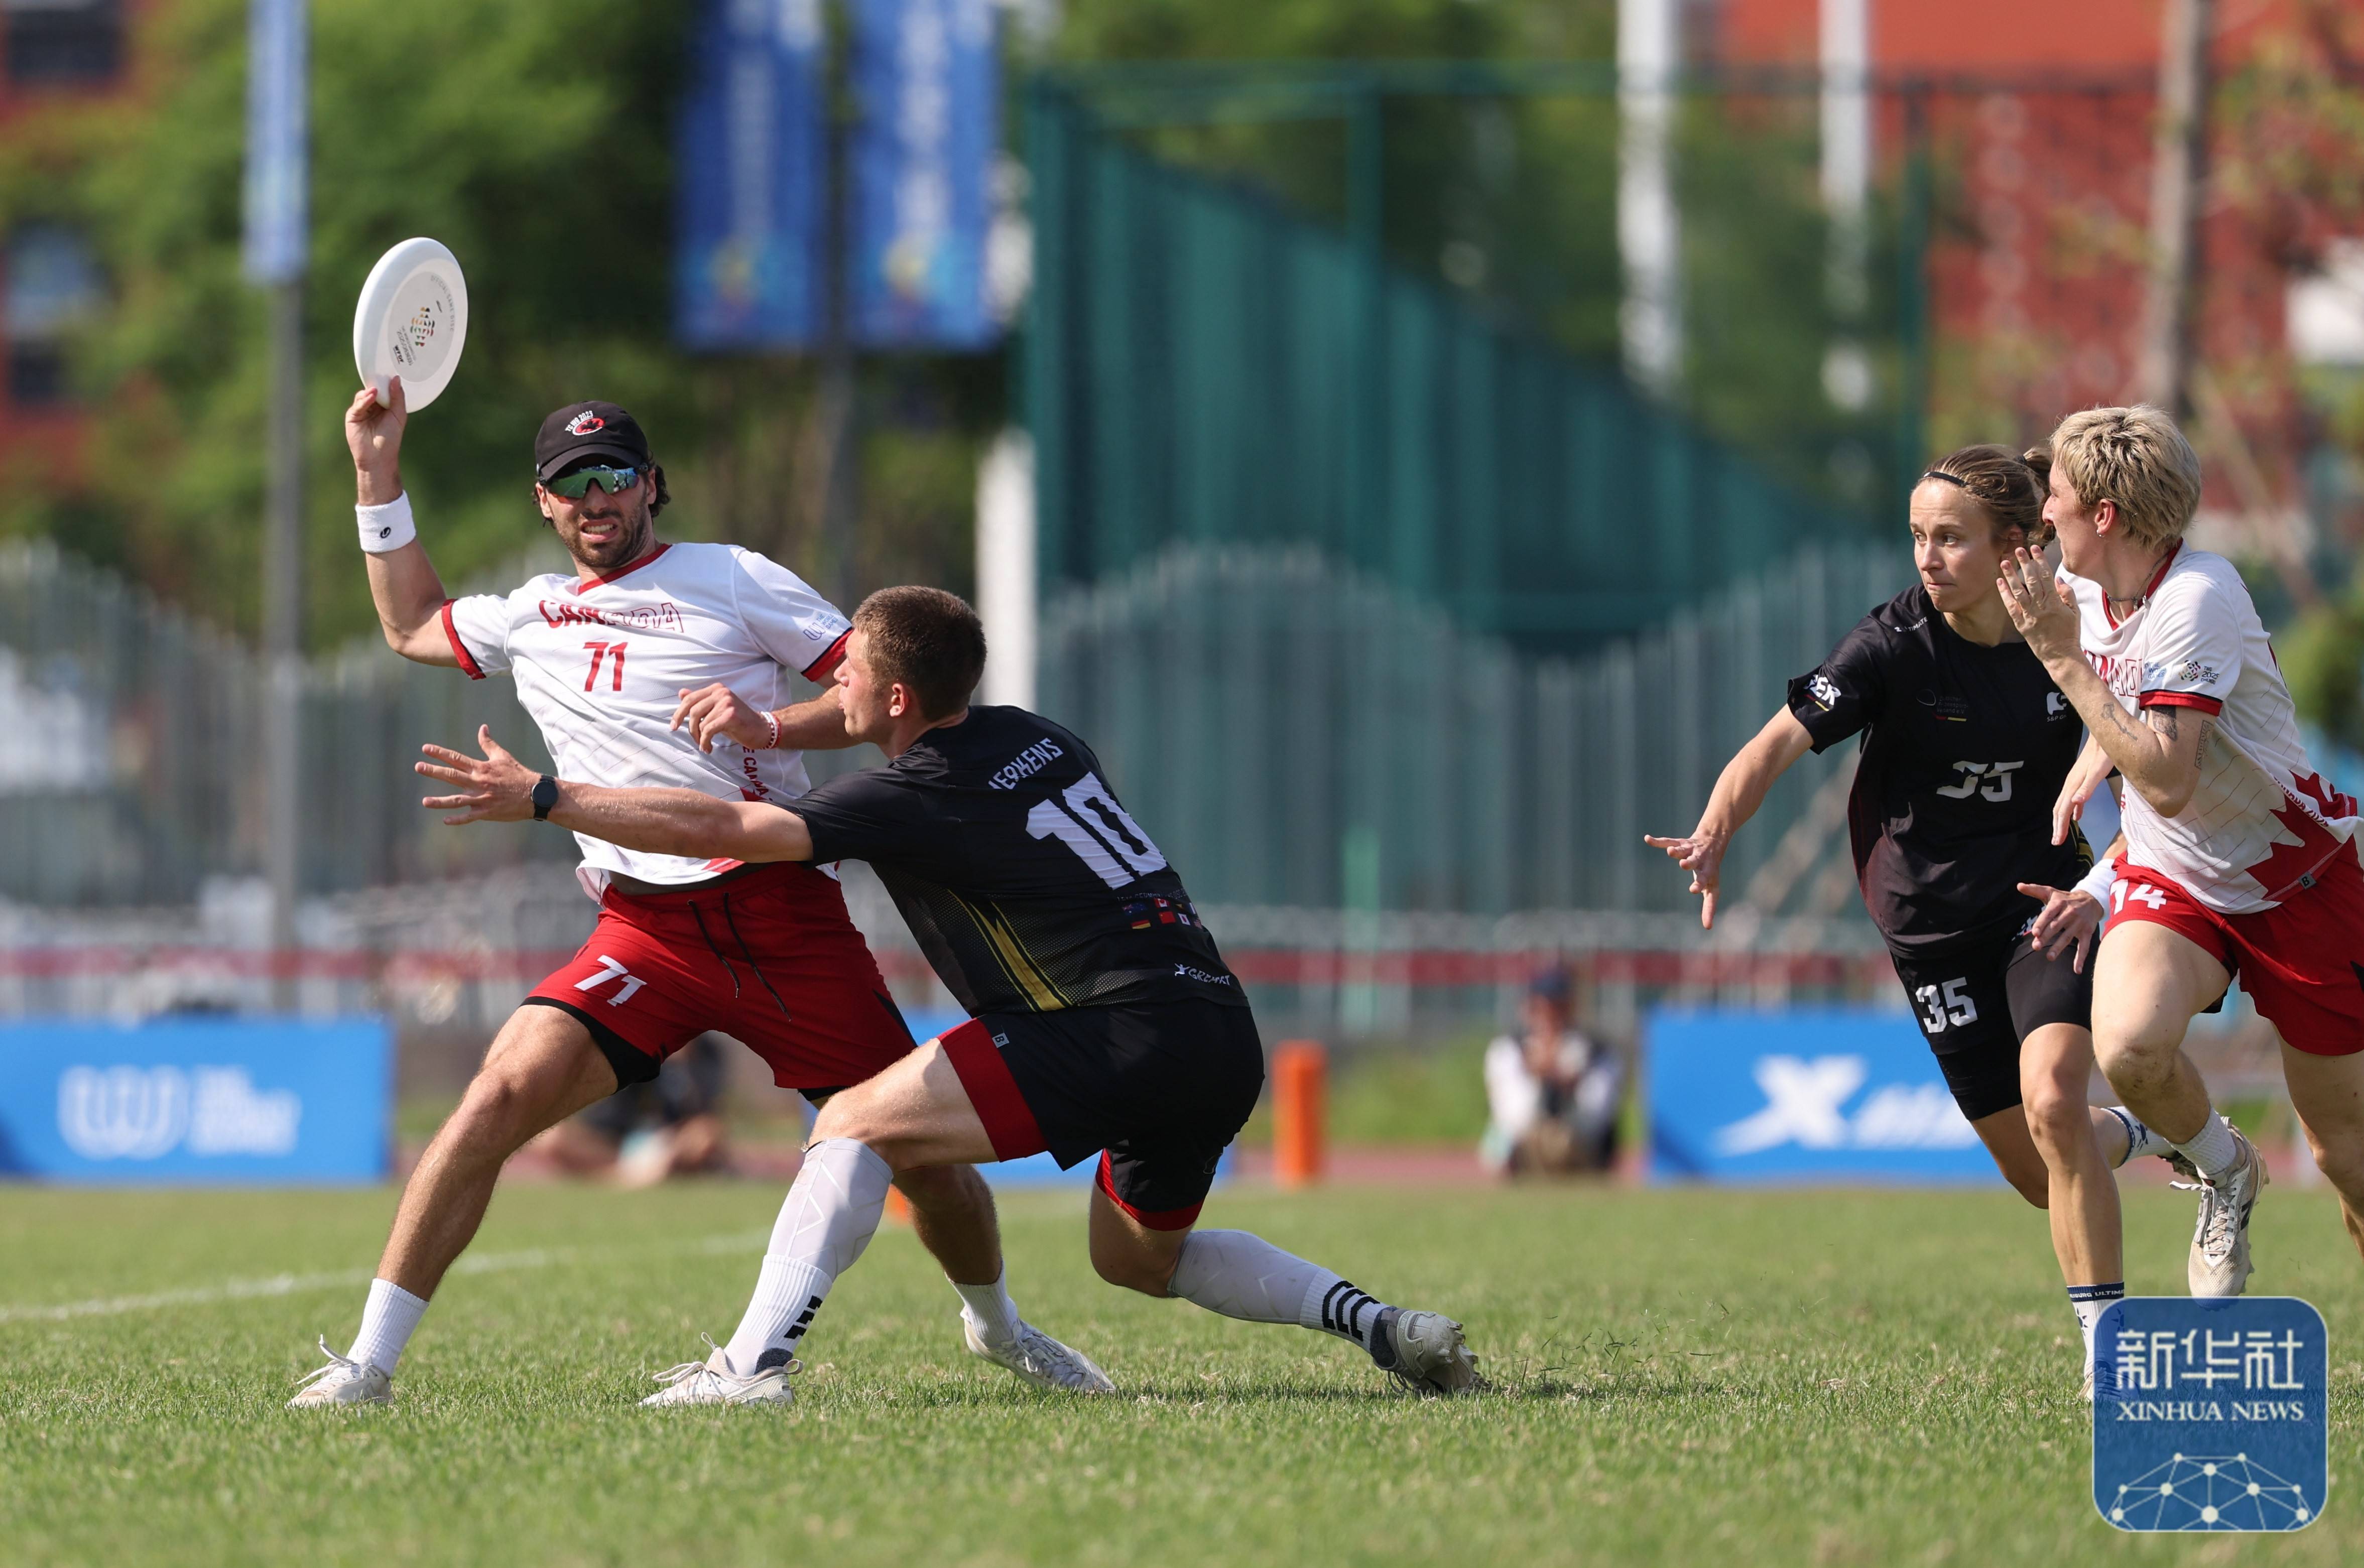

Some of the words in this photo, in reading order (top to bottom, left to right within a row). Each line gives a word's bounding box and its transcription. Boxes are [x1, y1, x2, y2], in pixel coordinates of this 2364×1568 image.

[539, 600, 689, 633] CANADA
[583, 642, 628, 692] 71
[1025, 771, 1167, 891] 10
[2109, 878, 2167, 915] 14
[574, 955, 647, 1006] 71
[1915, 977, 1978, 1033] 35
